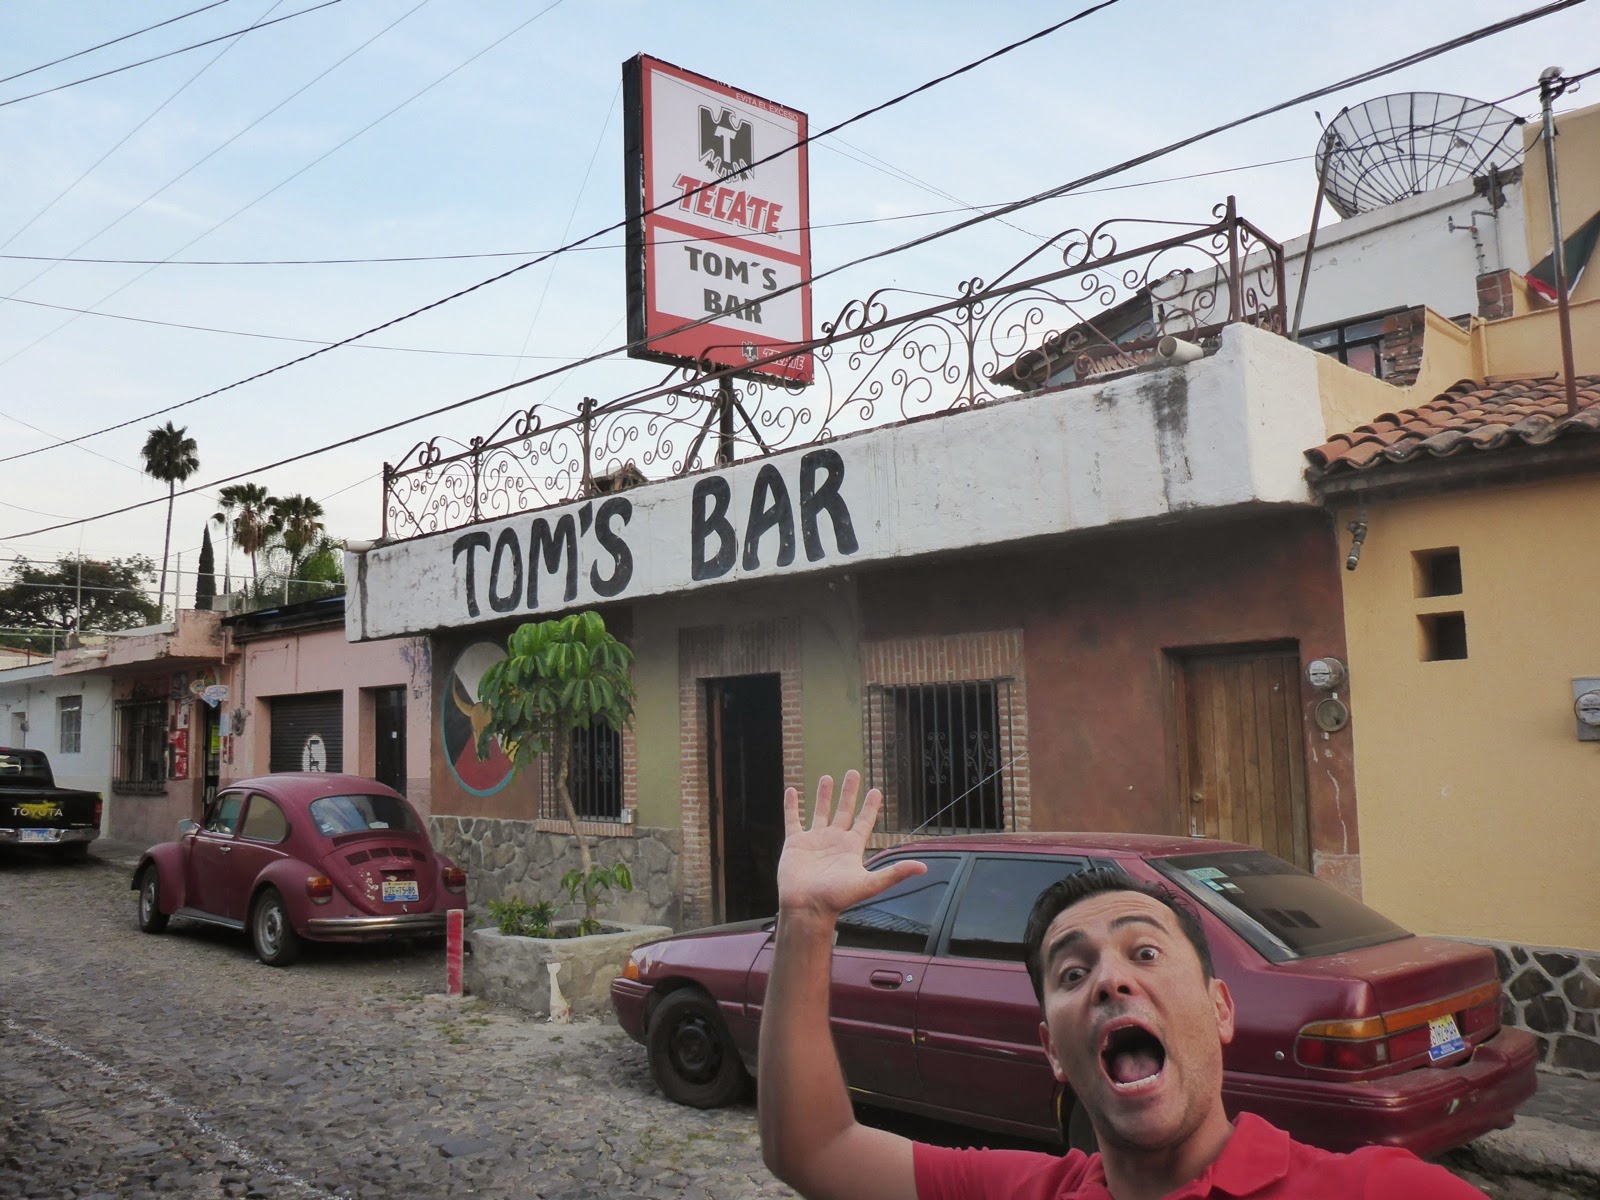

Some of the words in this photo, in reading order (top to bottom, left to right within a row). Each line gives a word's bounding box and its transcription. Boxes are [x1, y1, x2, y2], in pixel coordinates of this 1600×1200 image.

[735, 92, 758, 107] EVITA
[758, 101, 768, 111] EL
[769, 105, 798, 121] EXCESO
[714, 126, 737, 163] T
[673, 174, 783, 236] TECATE
[703, 288, 762, 324] BAR
[452, 497, 633, 617] TOM'S
[691, 448, 859, 581] BAR
[11, 807, 63, 817] TOYOTA
